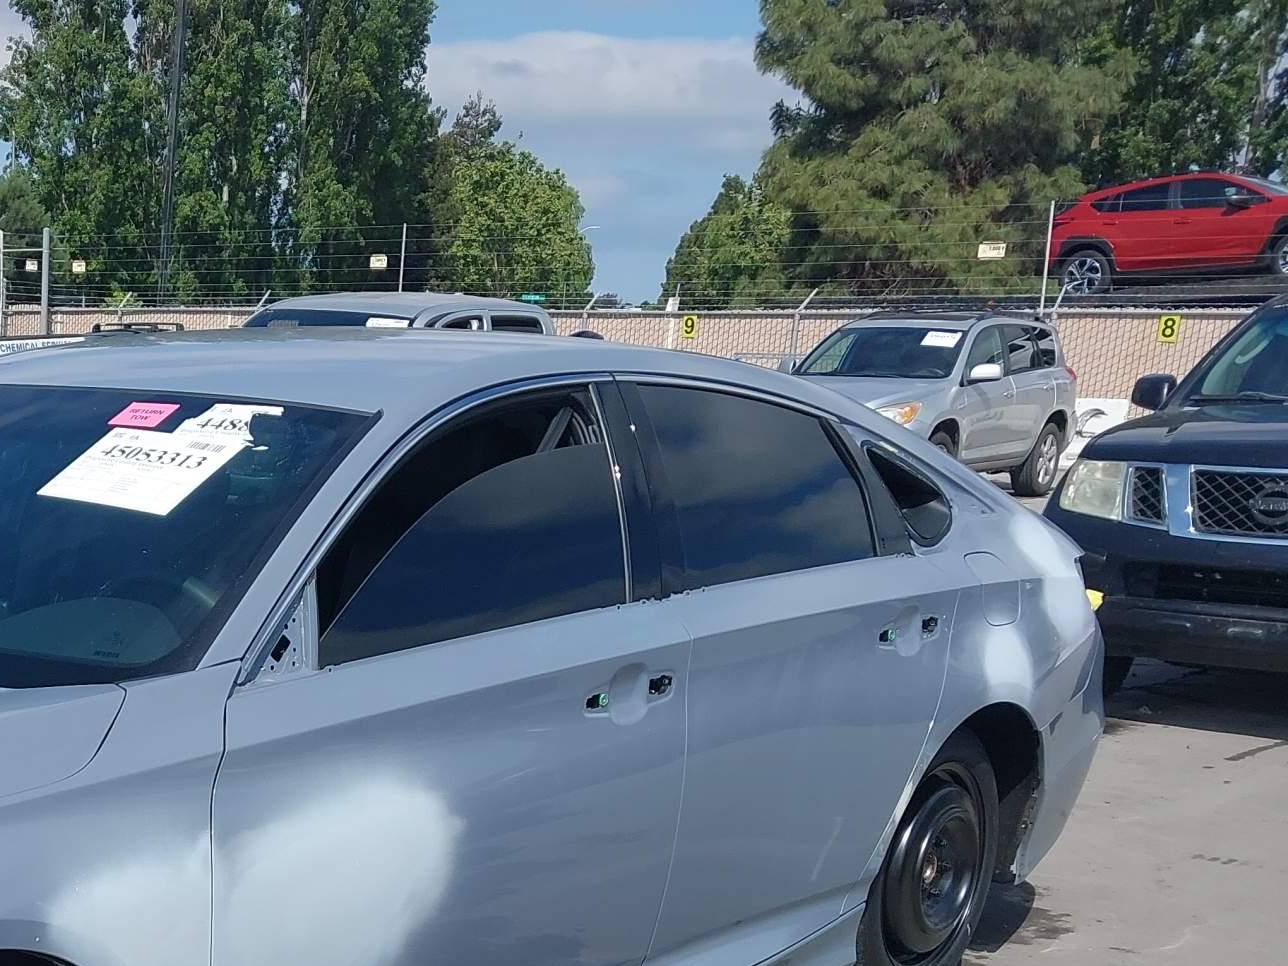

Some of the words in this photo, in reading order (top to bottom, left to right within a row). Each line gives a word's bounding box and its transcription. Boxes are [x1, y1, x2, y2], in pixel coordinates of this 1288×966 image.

[684, 316, 695, 335] 9
[1162, 317, 1176, 338] 8
[0, 341, 39, 353] CHEMICAL
[129, 408, 165, 416] RETURN
[100, 444, 208, 470] 45053313
